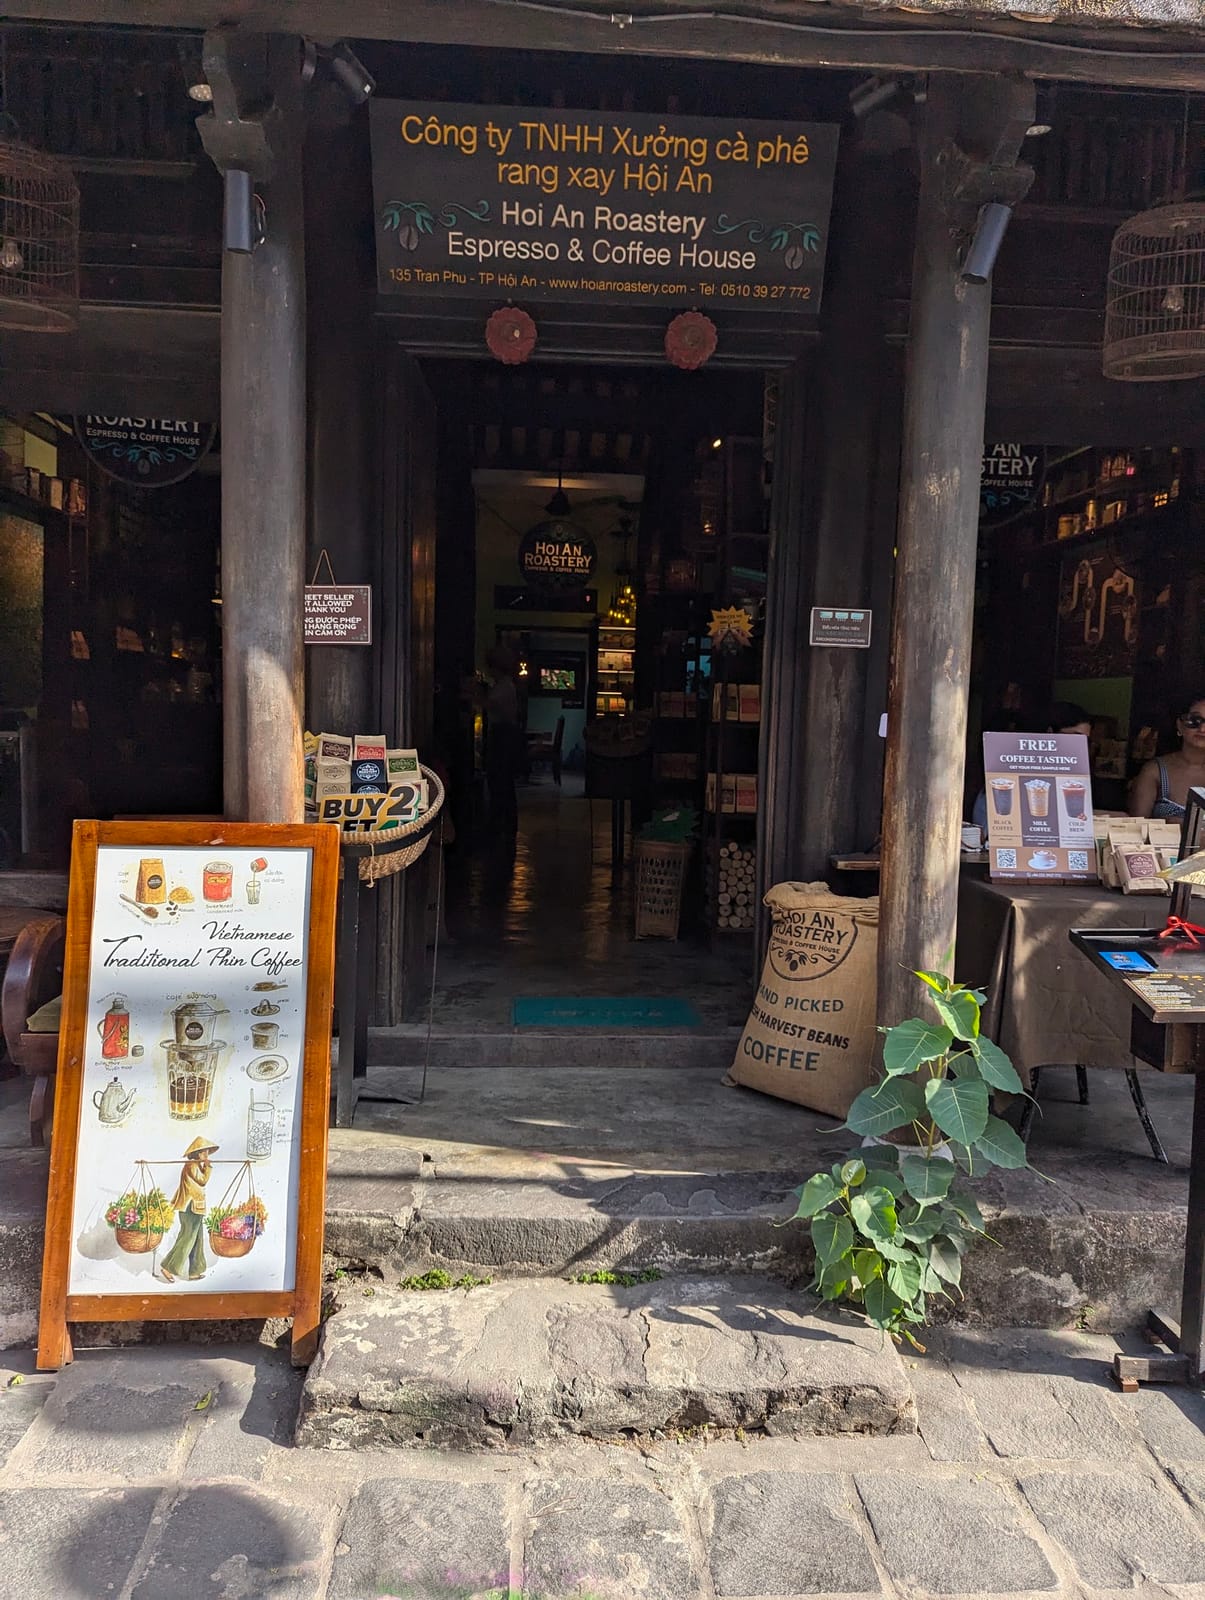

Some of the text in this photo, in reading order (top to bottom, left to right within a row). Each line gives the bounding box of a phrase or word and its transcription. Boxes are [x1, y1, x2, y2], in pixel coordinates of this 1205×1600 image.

[401, 115, 809, 169] Công ty TNHH Xưởng cà phê
[498, 162, 713, 197] rang xay Hội An
[502, 201, 706, 240] Hoi An Roastery
[448, 231, 756, 270] Espresso & Coffee House
[389, 268, 411, 281] 135
[414, 268, 440, 282] Tran
[443, 271, 467, 284] Phu
[479, 272, 495, 285] TP
[520, 274, 537, 287] An
[721, 283, 751, 297] 0510
[753, 284, 768, 298] 39
[771, 286, 785, 298] 27
[789, 287, 811, 300] 772
[524, 552, 592, 568] ROASTERY
[535, 541, 582, 557] HOI AN
[1000, 754, 1077, 764] COFFEE TASTING
[1019, 739, 1057, 752] FREE
[323, 786, 414, 818] BUY 2
[325, 819, 376, 832] ET
[202, 921, 294, 941] Vietnamese
[810, 911, 835, 930] AN
[103, 935, 303, 976] Traditional Phin Coffee
[758, 984, 844, 1013] AND PICKED
[759, 1010, 806, 1039] HARVEST
[807, 1028, 850, 1050] BEANS
[743, 1036, 820, 1072] COFFEE
